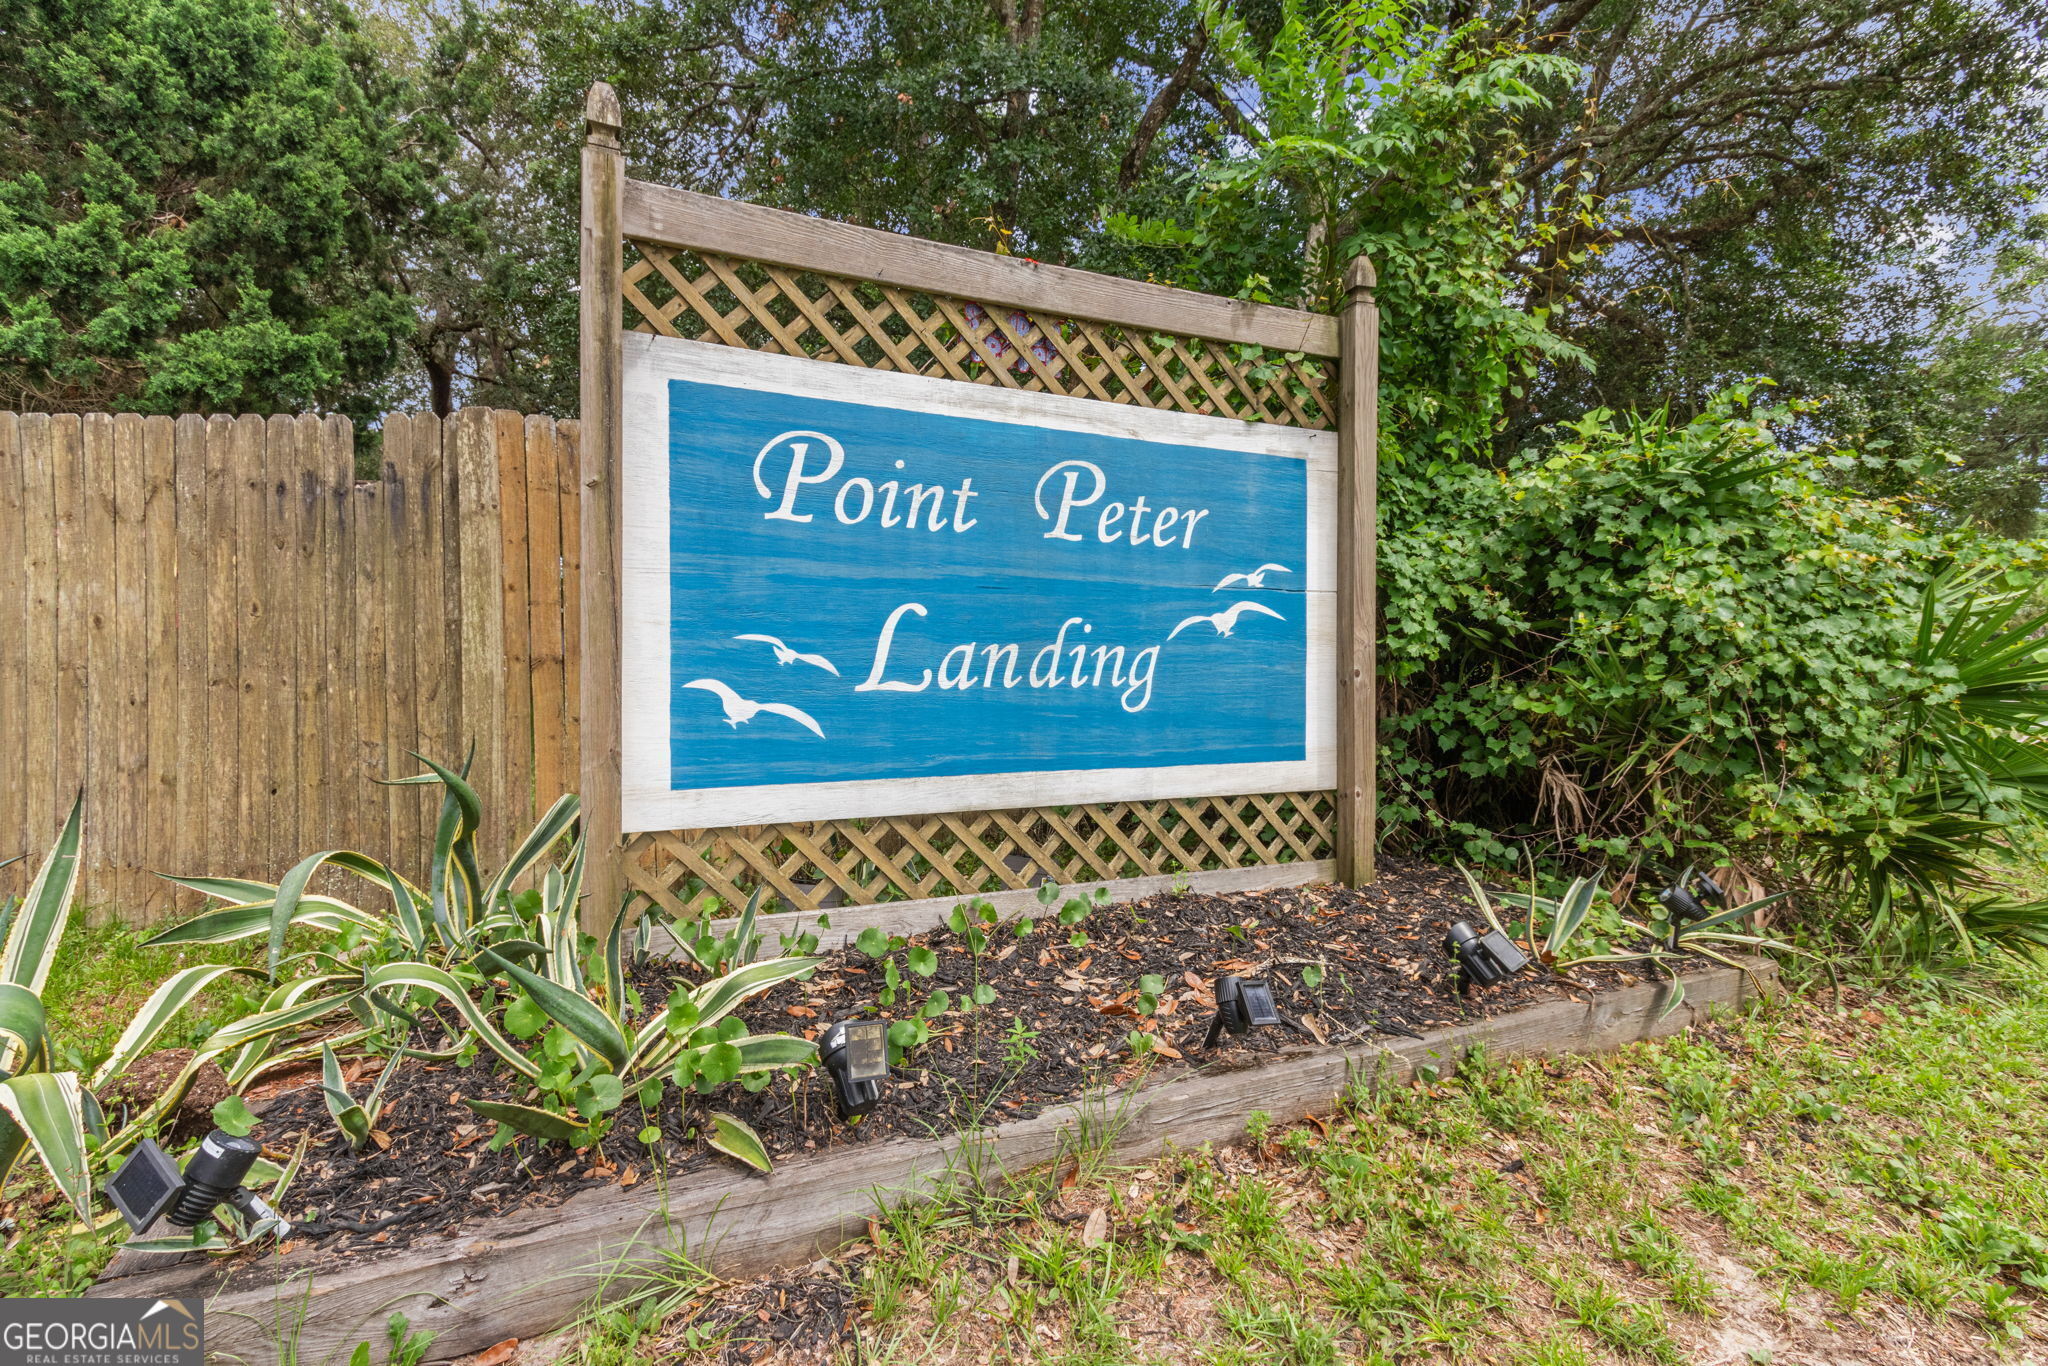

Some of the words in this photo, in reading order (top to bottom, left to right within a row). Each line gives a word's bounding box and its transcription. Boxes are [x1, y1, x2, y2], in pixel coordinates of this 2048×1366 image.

[753, 430, 979, 533] Point
[1035, 460, 1209, 549] Peter
[855, 602, 1161, 713] Landing
